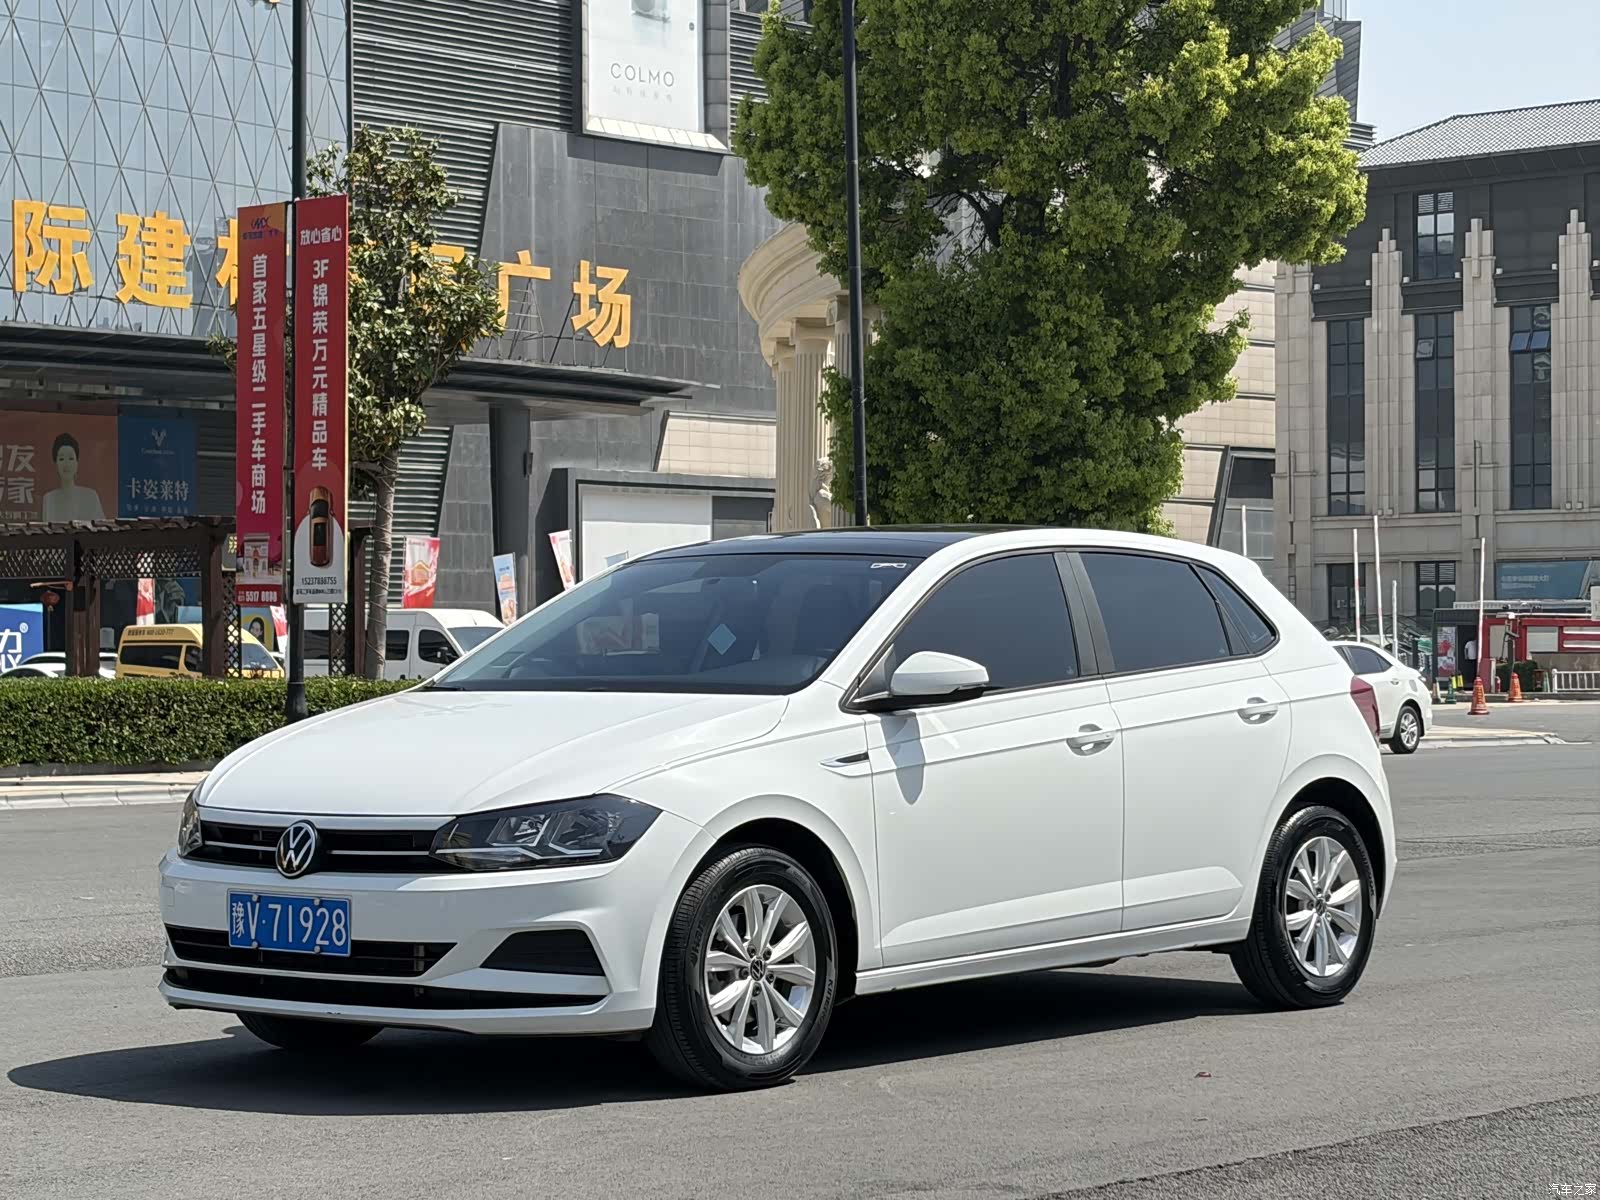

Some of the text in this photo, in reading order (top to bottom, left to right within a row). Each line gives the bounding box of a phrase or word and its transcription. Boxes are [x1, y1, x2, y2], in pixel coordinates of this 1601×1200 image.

[610, 62, 675, 88] COLMO
[300, 225, 343, 246] 放心省心
[311, 258, 330, 472] 3F锦荣万元精品车
[251, 254, 268, 515] 首家五星级二手车商场
[126, 477, 189, 502] 卡姿莱特
